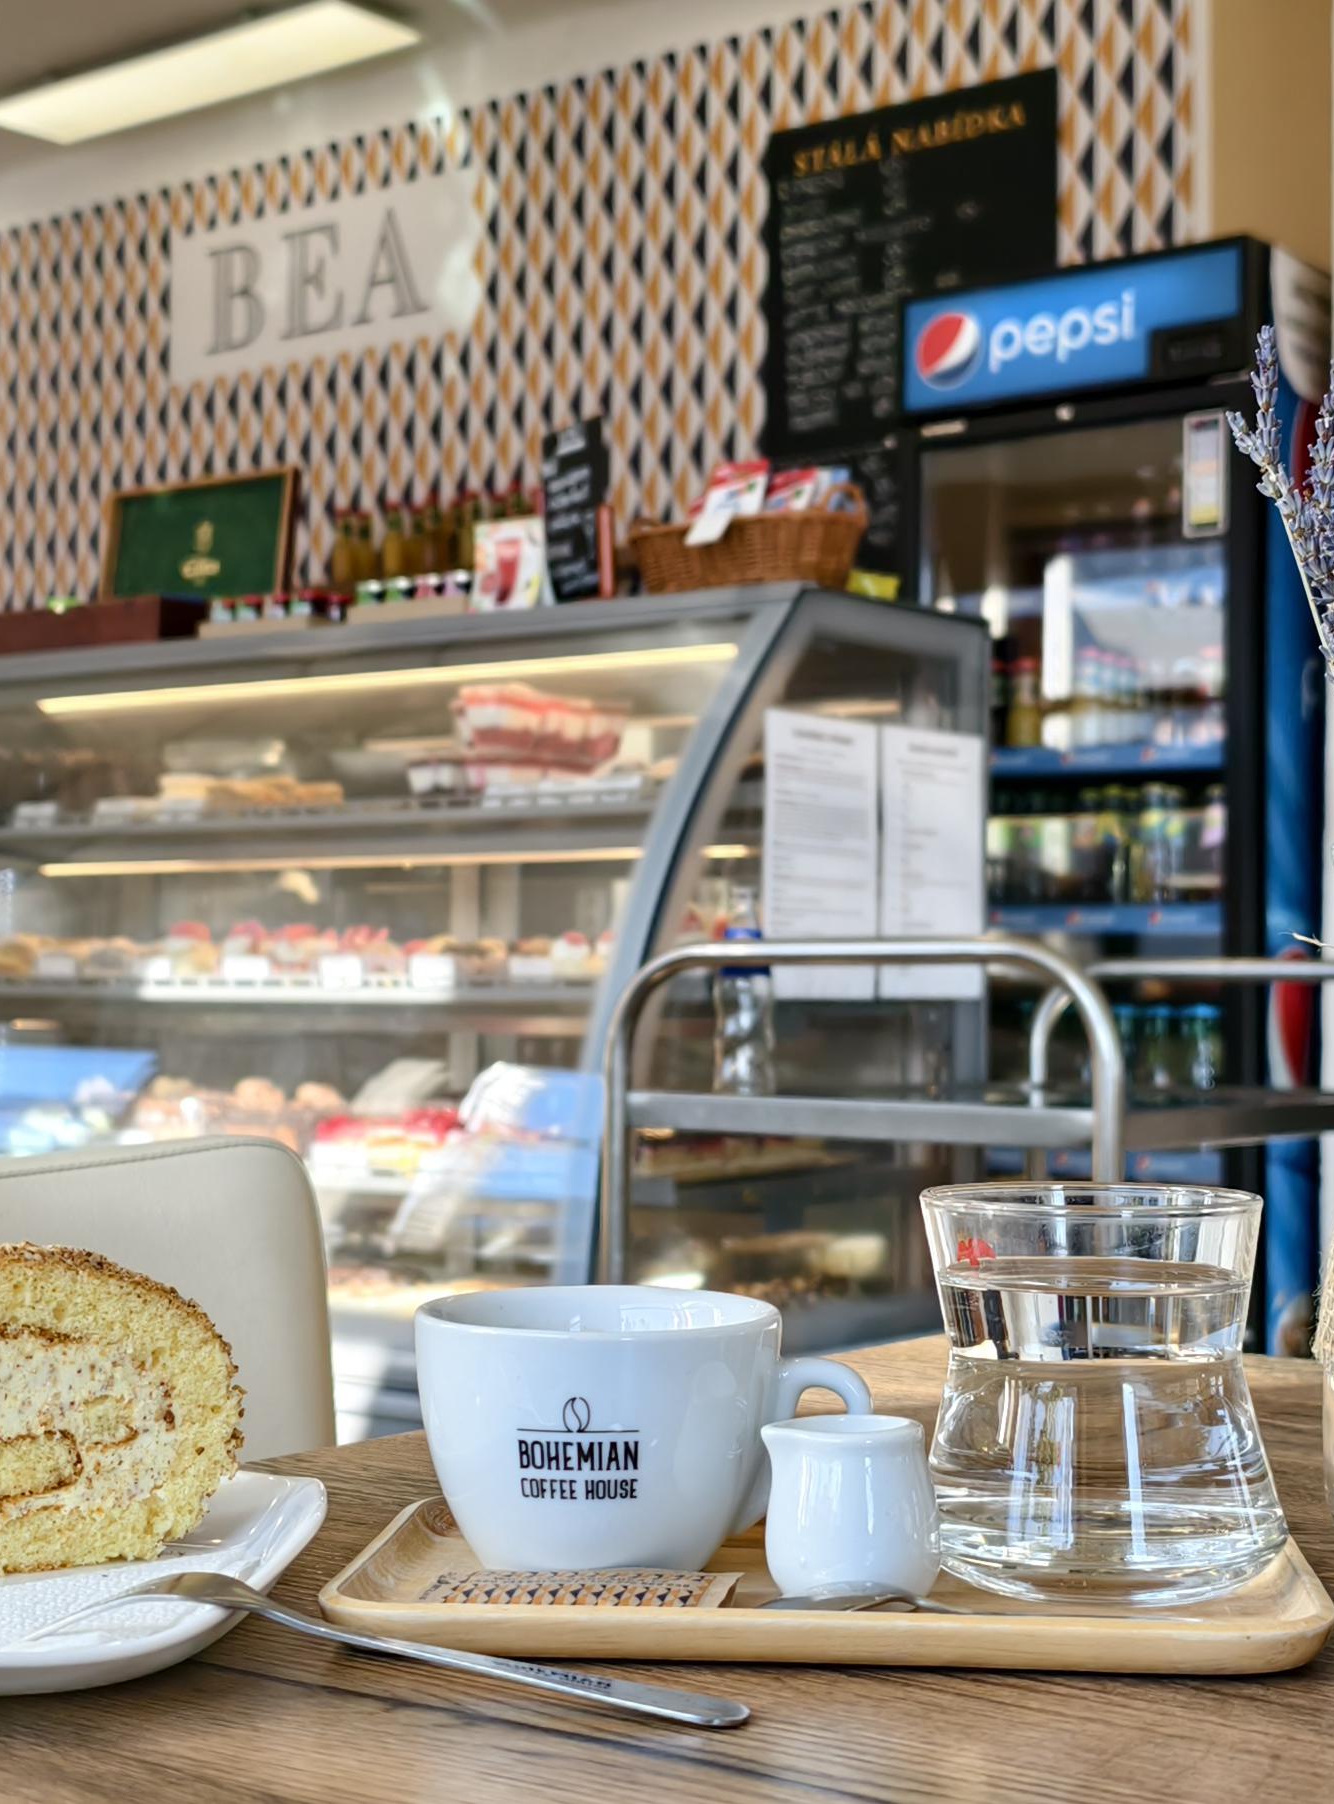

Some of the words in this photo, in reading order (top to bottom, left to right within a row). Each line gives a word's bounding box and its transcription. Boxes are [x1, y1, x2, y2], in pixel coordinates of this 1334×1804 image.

[891, 99, 1026, 155] NABÍDKA
[205, 205, 430, 356] BEA
[988, 287, 1136, 374] pepsi
[517, 1439, 639, 1471] BOHEMIAN
[520, 1477, 577, 1500] COFFEE
[584, 1478, 638, 1500] HOUSE
